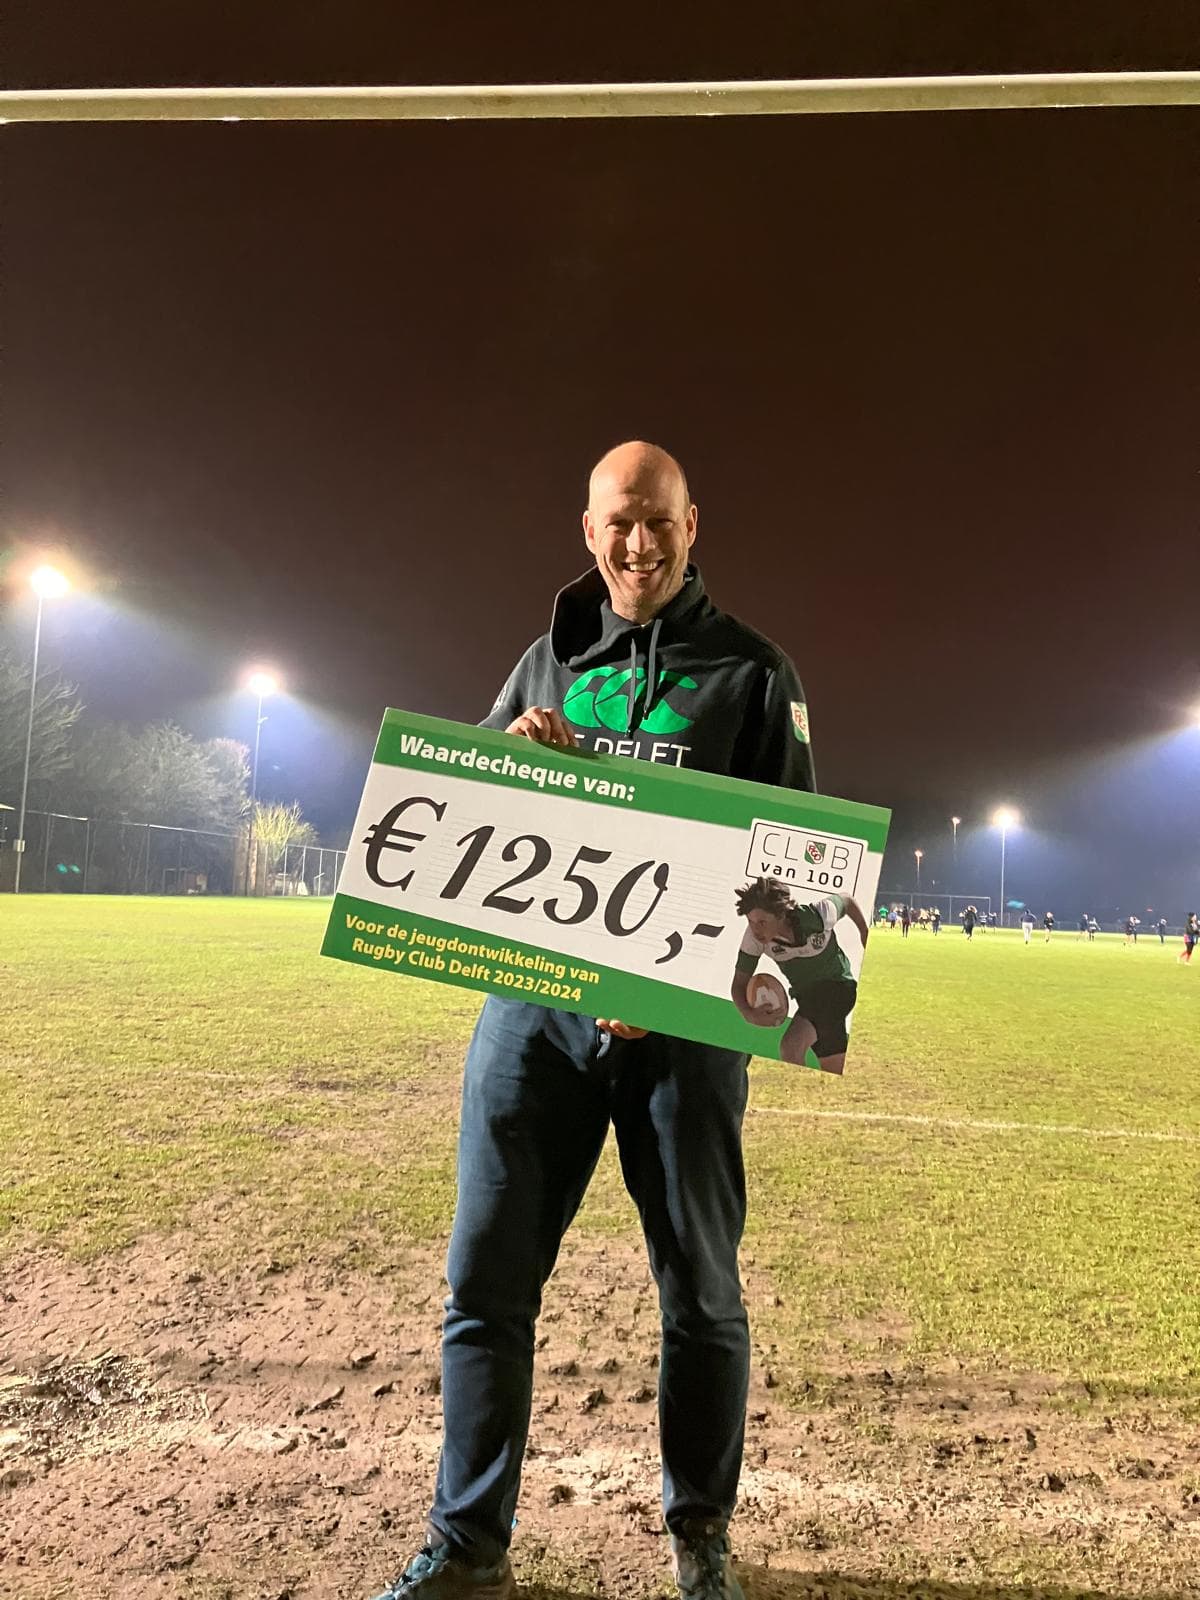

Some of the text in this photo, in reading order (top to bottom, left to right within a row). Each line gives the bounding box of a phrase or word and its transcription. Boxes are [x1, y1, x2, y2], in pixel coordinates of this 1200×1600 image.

[400, 734, 635, 801] Waardecheque van:
[761, 862, 843, 888] van 100
[345, 914, 600, 984] Voor de jeugdontwikkeling van
[352, 937, 582, 1002] Rugby Club Delft 2023/2024
